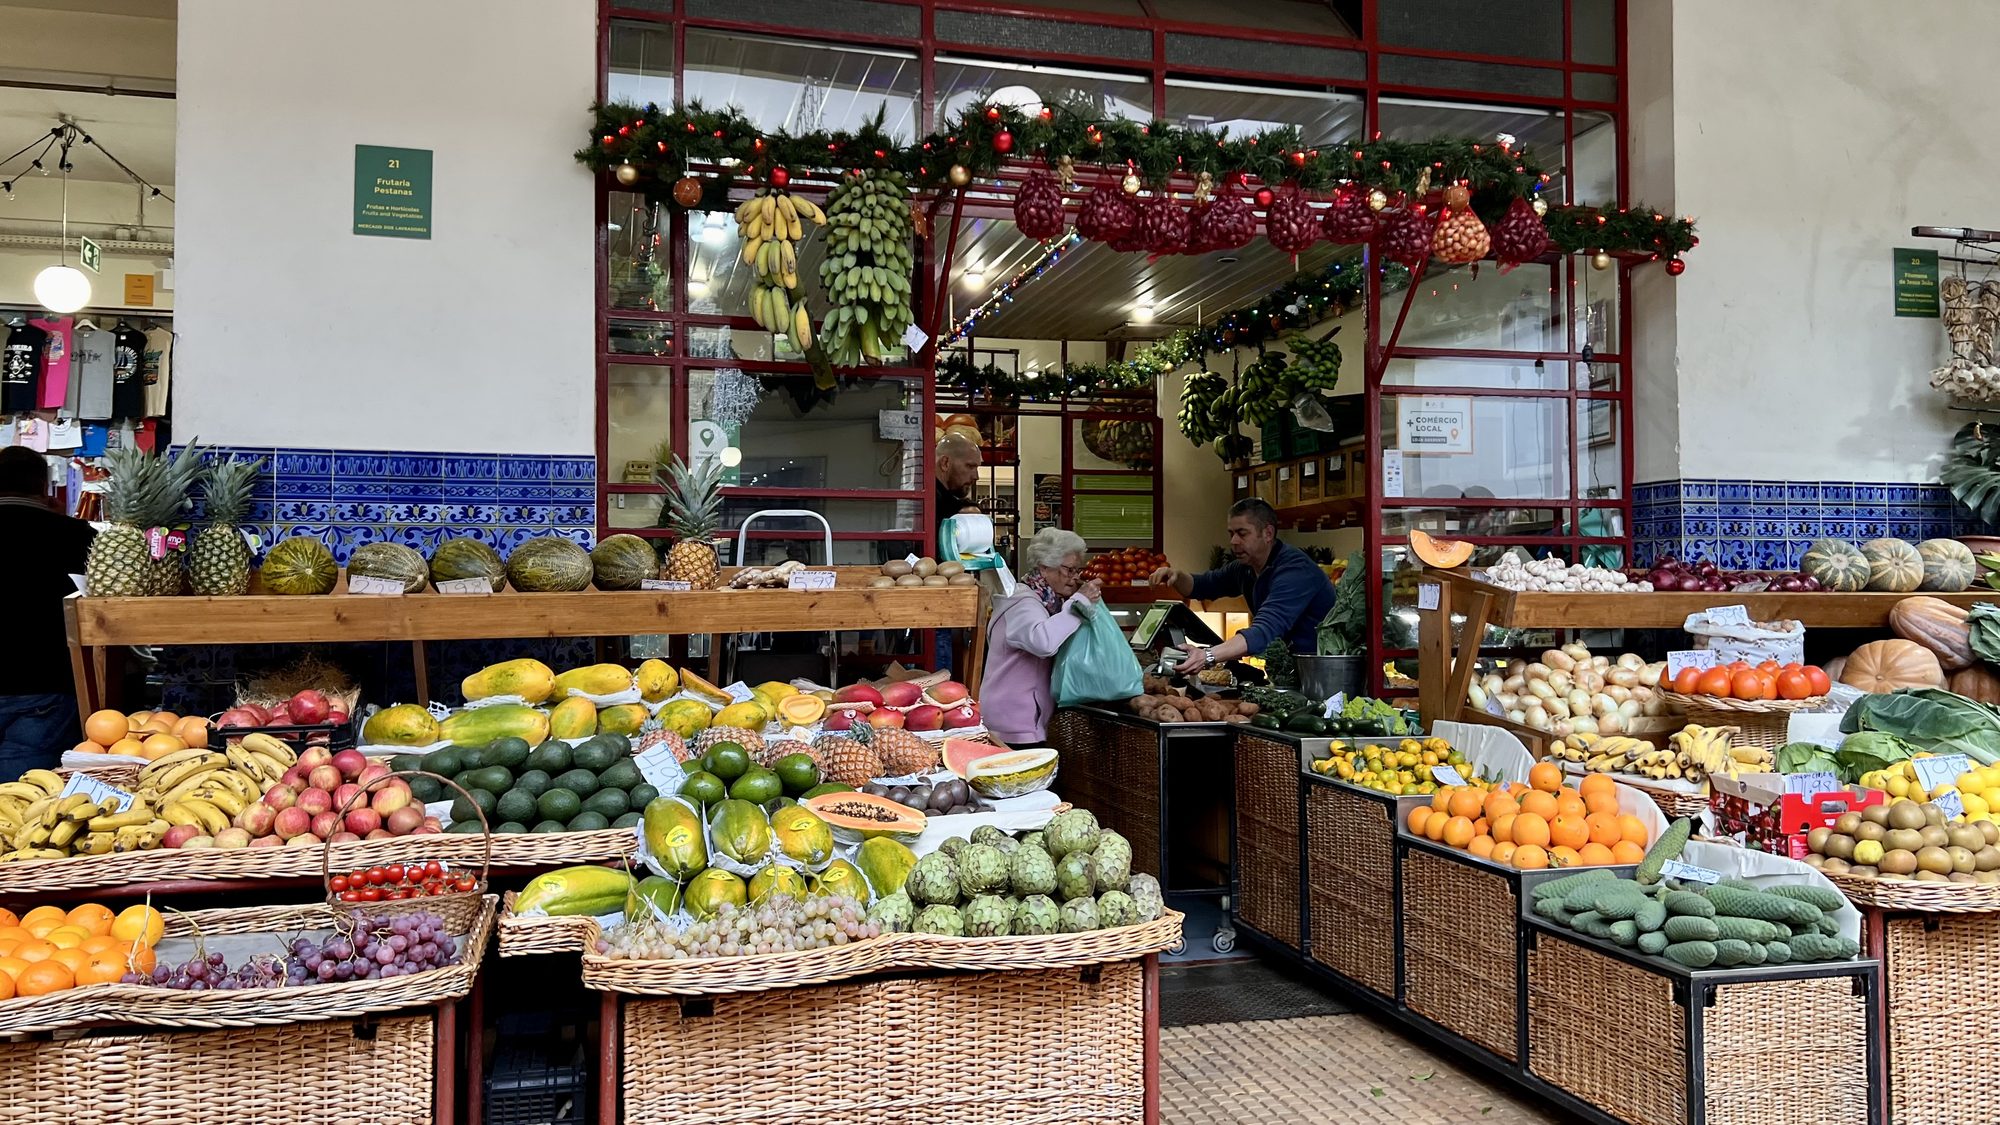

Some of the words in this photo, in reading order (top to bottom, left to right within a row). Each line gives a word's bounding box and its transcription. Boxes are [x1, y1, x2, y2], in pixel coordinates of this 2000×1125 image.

[388, 159, 400, 169] 21
[376, 178, 411, 188] Frutaria
[374, 187, 413, 196] Pestanas
[1416, 415, 1458, 424] COMÉRCIO
